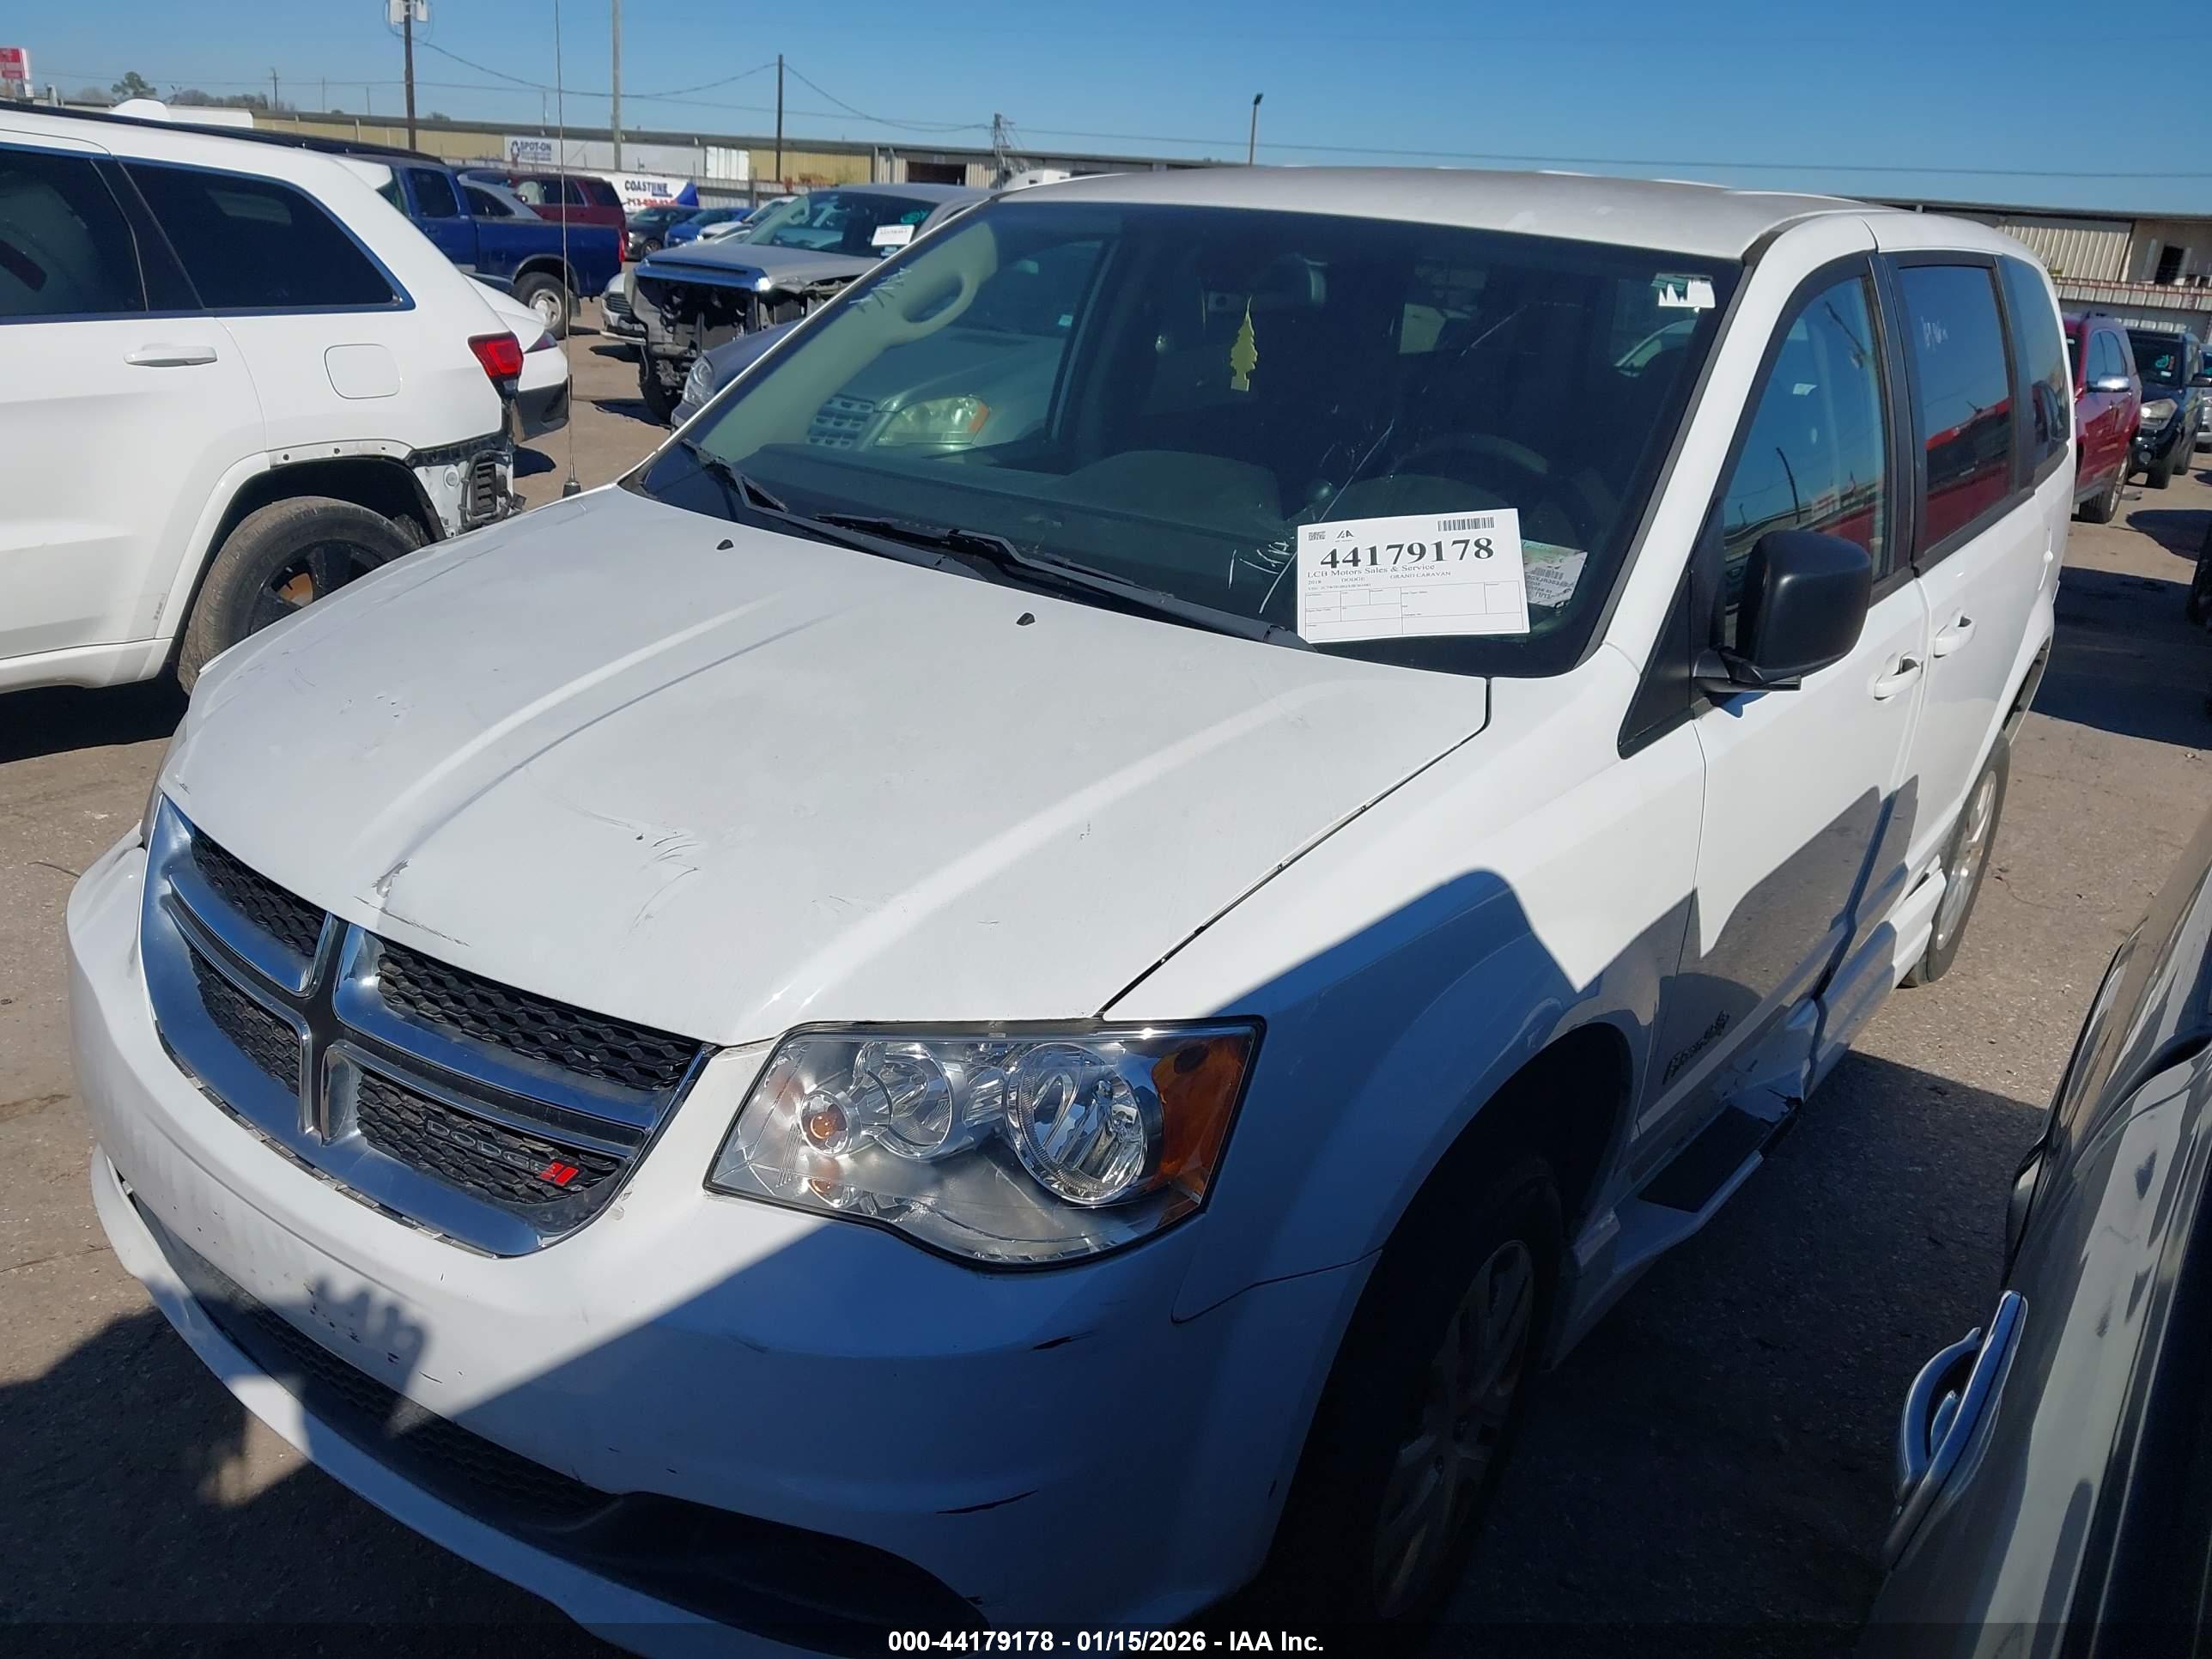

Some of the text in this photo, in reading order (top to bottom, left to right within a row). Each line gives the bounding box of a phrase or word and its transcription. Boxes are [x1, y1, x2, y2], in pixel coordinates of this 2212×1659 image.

[520, 141, 552, 152] SPOT-ON
[1320, 537, 1494, 568] 44179178
[1331, 567, 1362, 576] Motors
[1364, 565, 1388, 574] Sales
[1389, 563, 1398, 573] &
[1401, 563, 1435, 572] Service
[427, 1120, 553, 1175] DODGE
